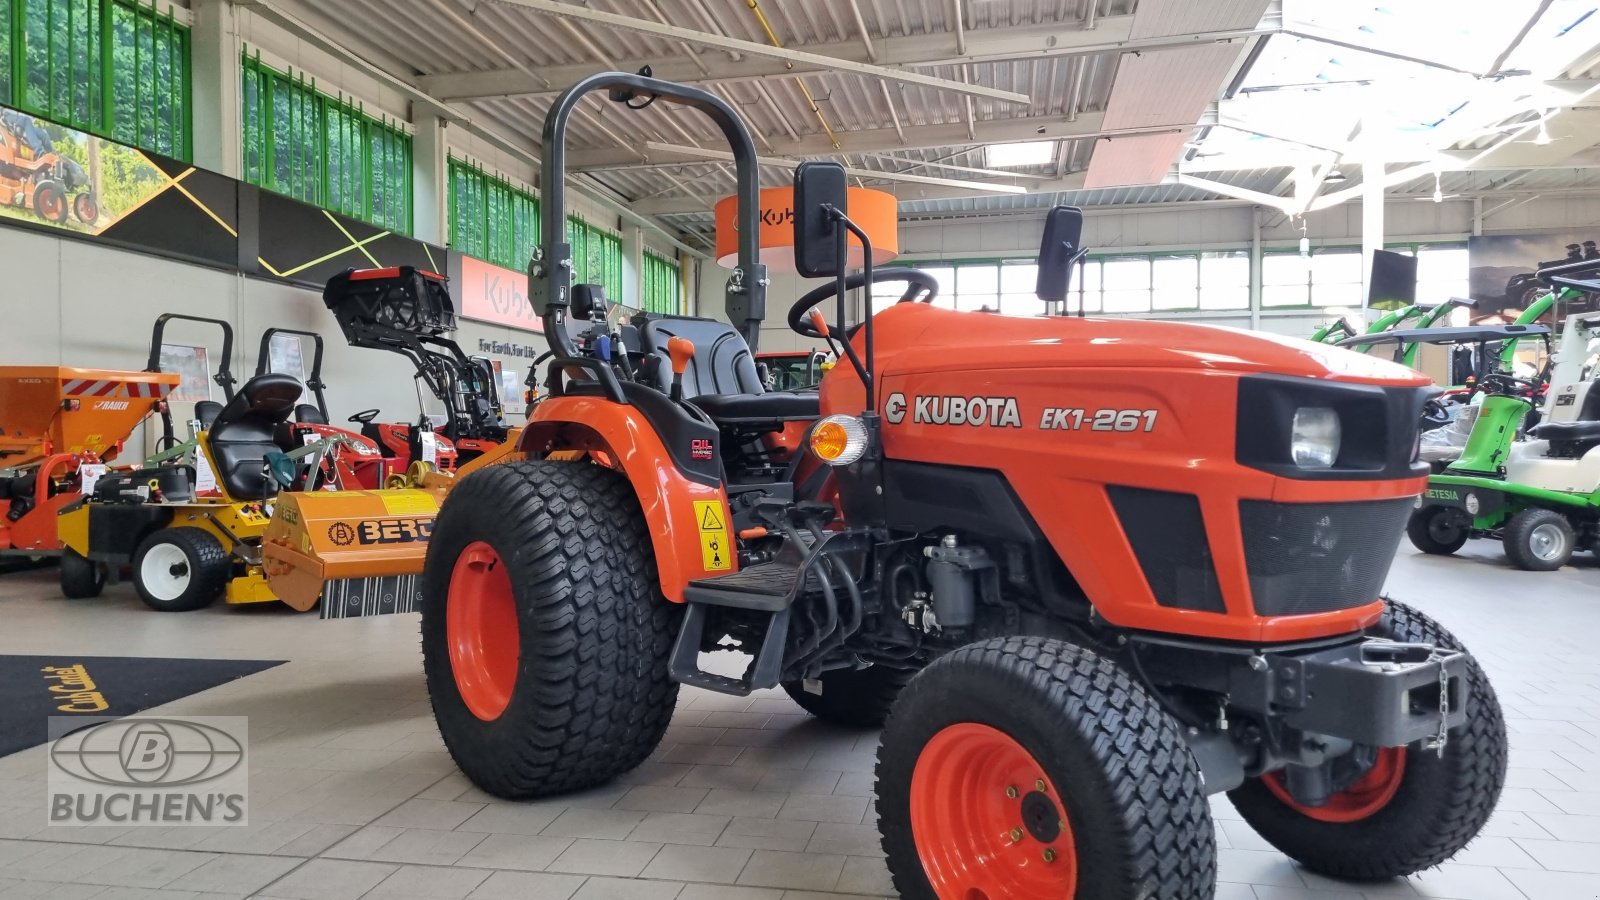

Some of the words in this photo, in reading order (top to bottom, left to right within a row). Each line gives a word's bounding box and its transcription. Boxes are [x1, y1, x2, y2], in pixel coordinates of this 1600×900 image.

[479, 338, 491, 352] For
[512, 344, 524, 357] For
[524, 346, 536, 359] Life
[914, 396, 1022, 428] KUBOTA
[1040, 408, 1158, 431] EK1-261
[692, 440, 713, 449] OIL
